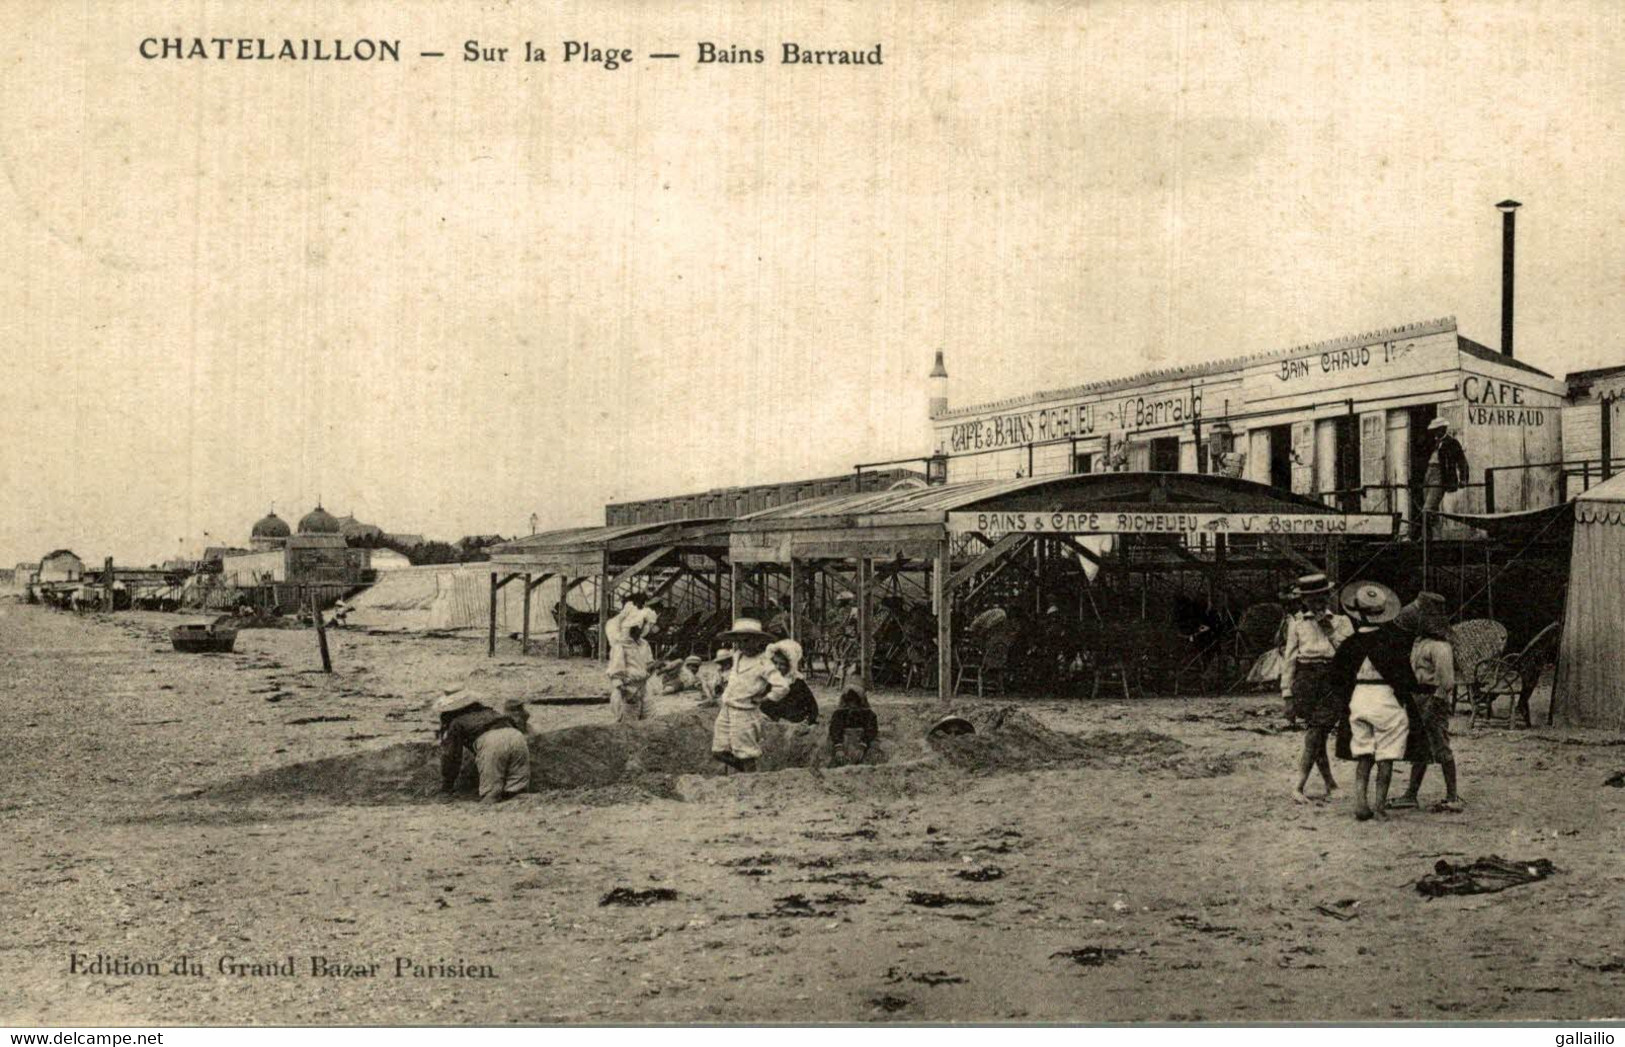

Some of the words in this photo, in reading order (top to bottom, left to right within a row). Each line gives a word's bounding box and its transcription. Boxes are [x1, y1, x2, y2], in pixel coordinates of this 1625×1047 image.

[1276, 359, 1309, 381] BAIN
[1320, 347, 1370, 373] CHAUD
[1463, 376, 1525, 405] CAFE
[994, 413, 1034, 447] BAINS
[1040, 404, 1094, 440] RICHELIEU
[1136, 389, 1202, 426] Barraud
[978, 514, 1026, 530] BAINS
[1034, 517, 1044, 530] &
[1117, 514, 1198, 532] RICHELIEU
[1264, 514, 1347, 533] Barraud
